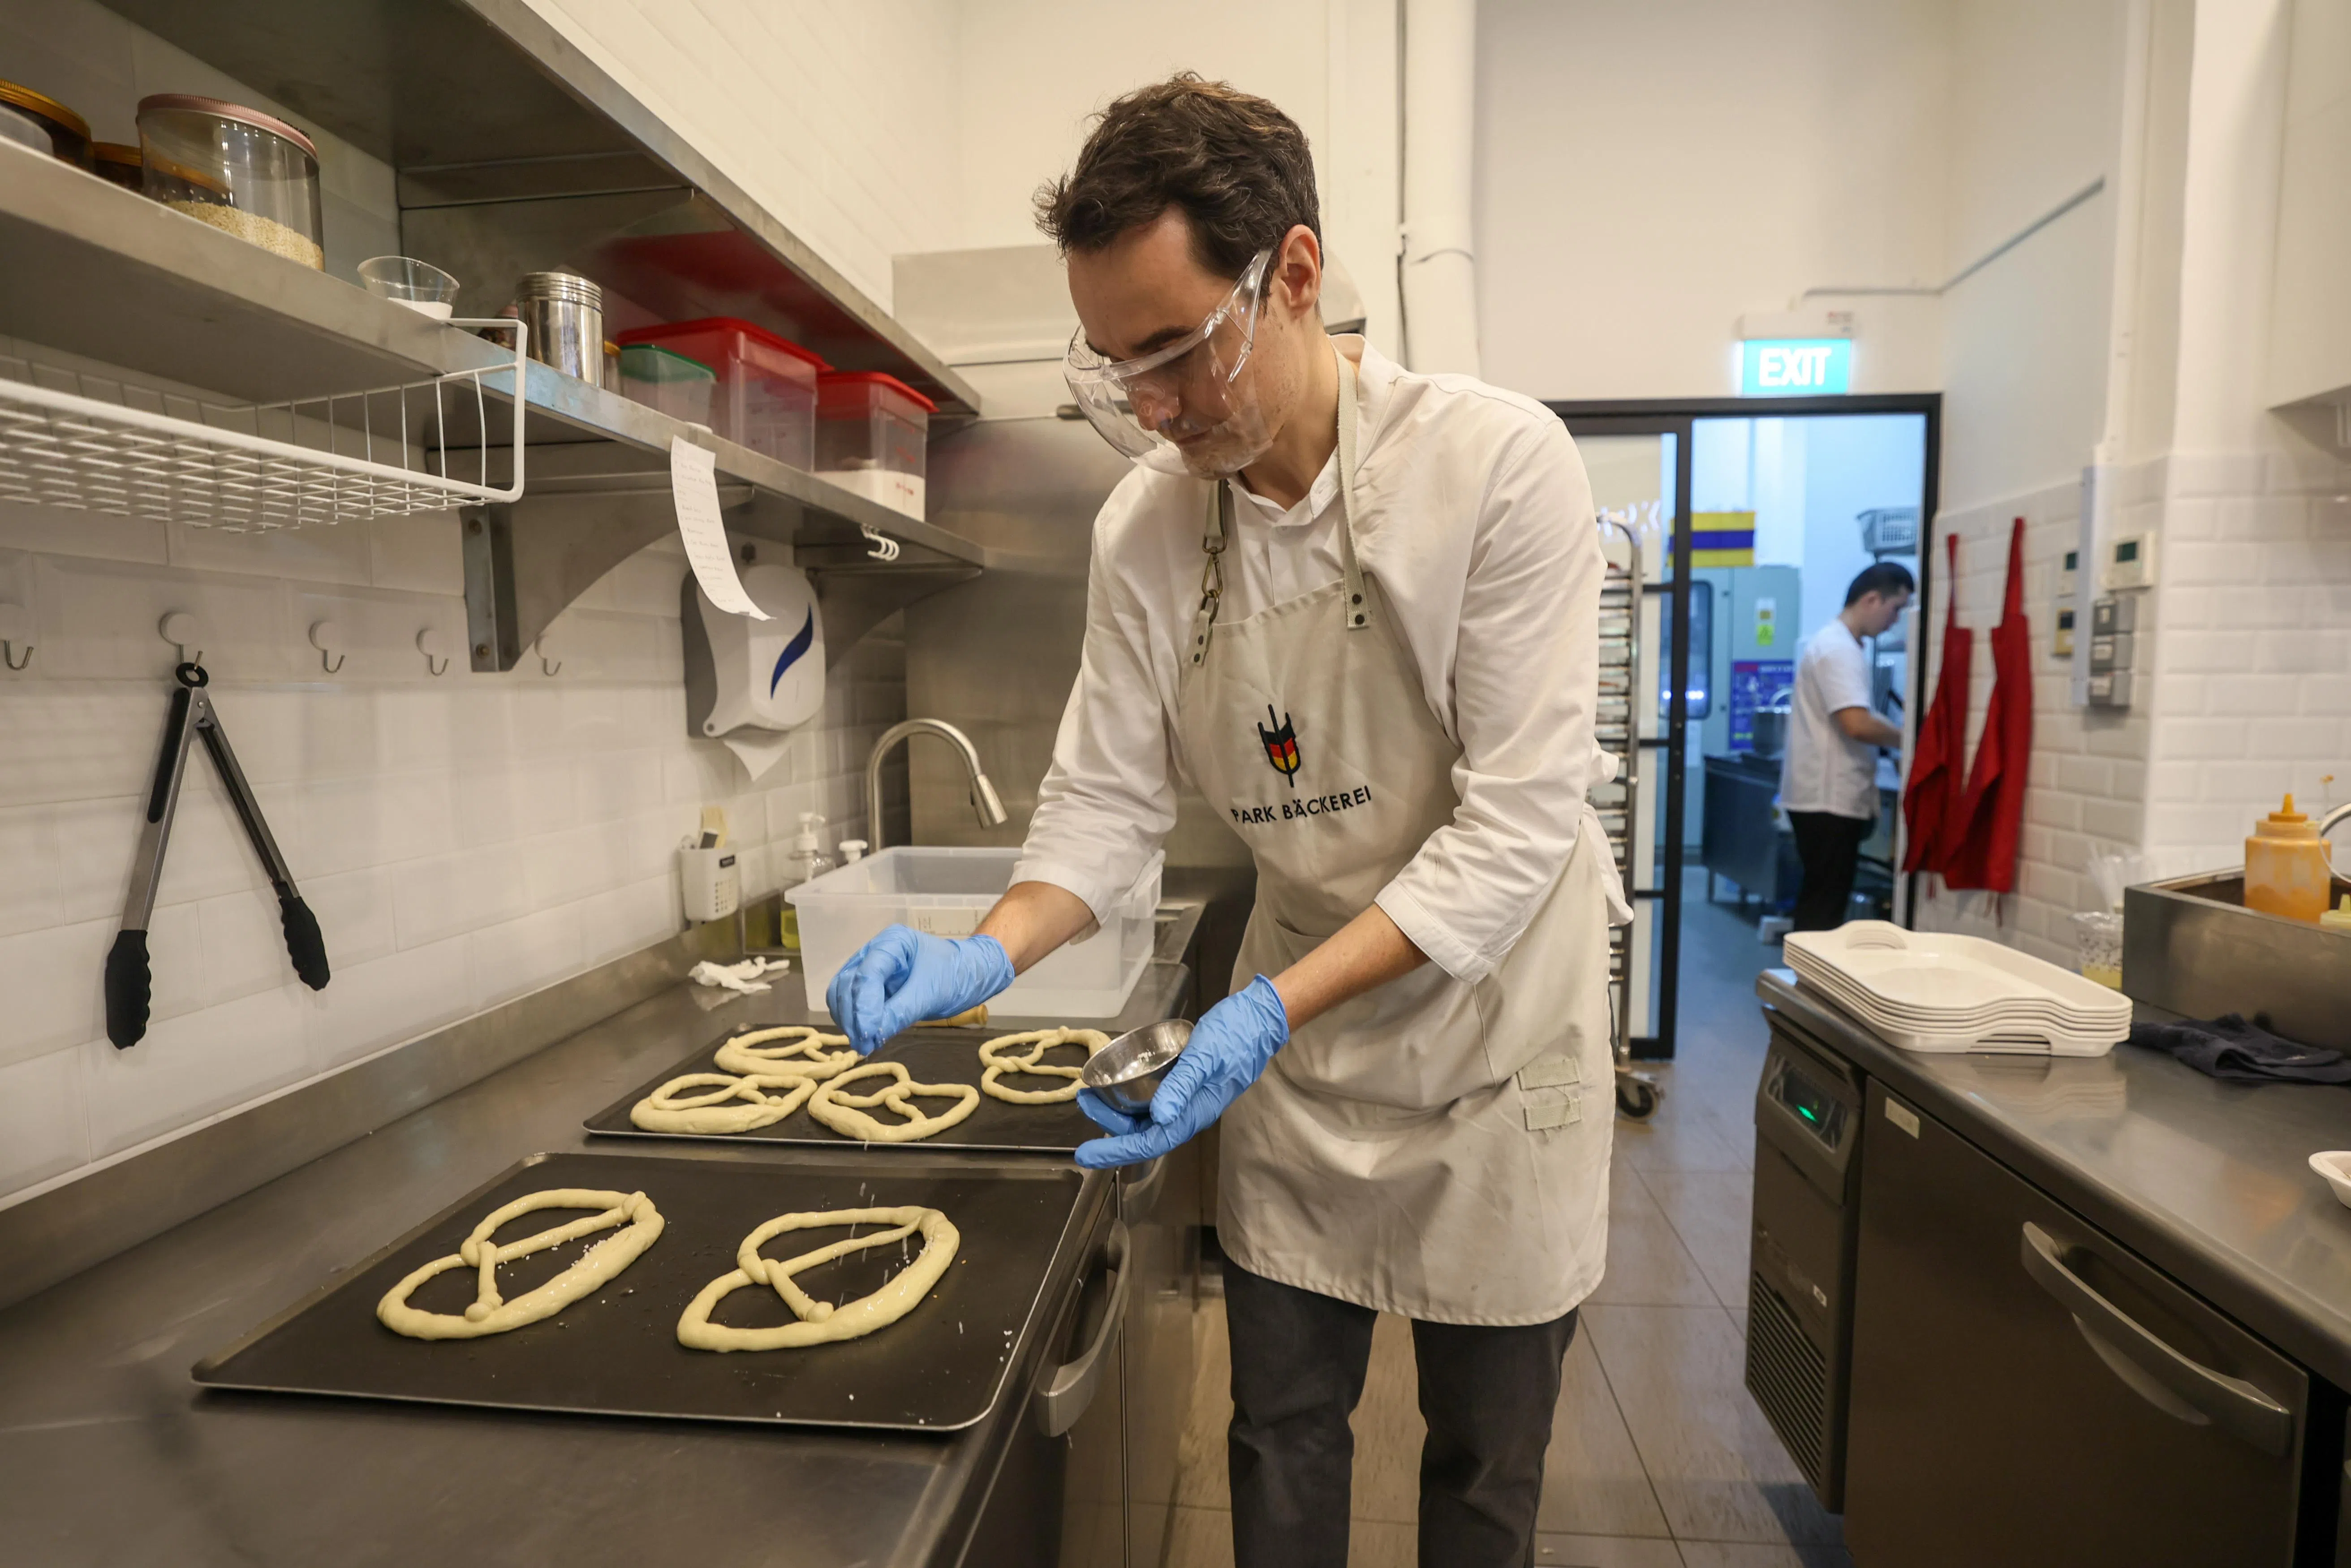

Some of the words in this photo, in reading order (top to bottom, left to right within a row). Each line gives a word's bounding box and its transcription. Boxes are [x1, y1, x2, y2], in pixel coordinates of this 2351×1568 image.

[1759, 347, 1832, 386] EXIT
[1231, 806, 1277, 823] PARK
[1282, 785, 1371, 819] BÄCKEREI
